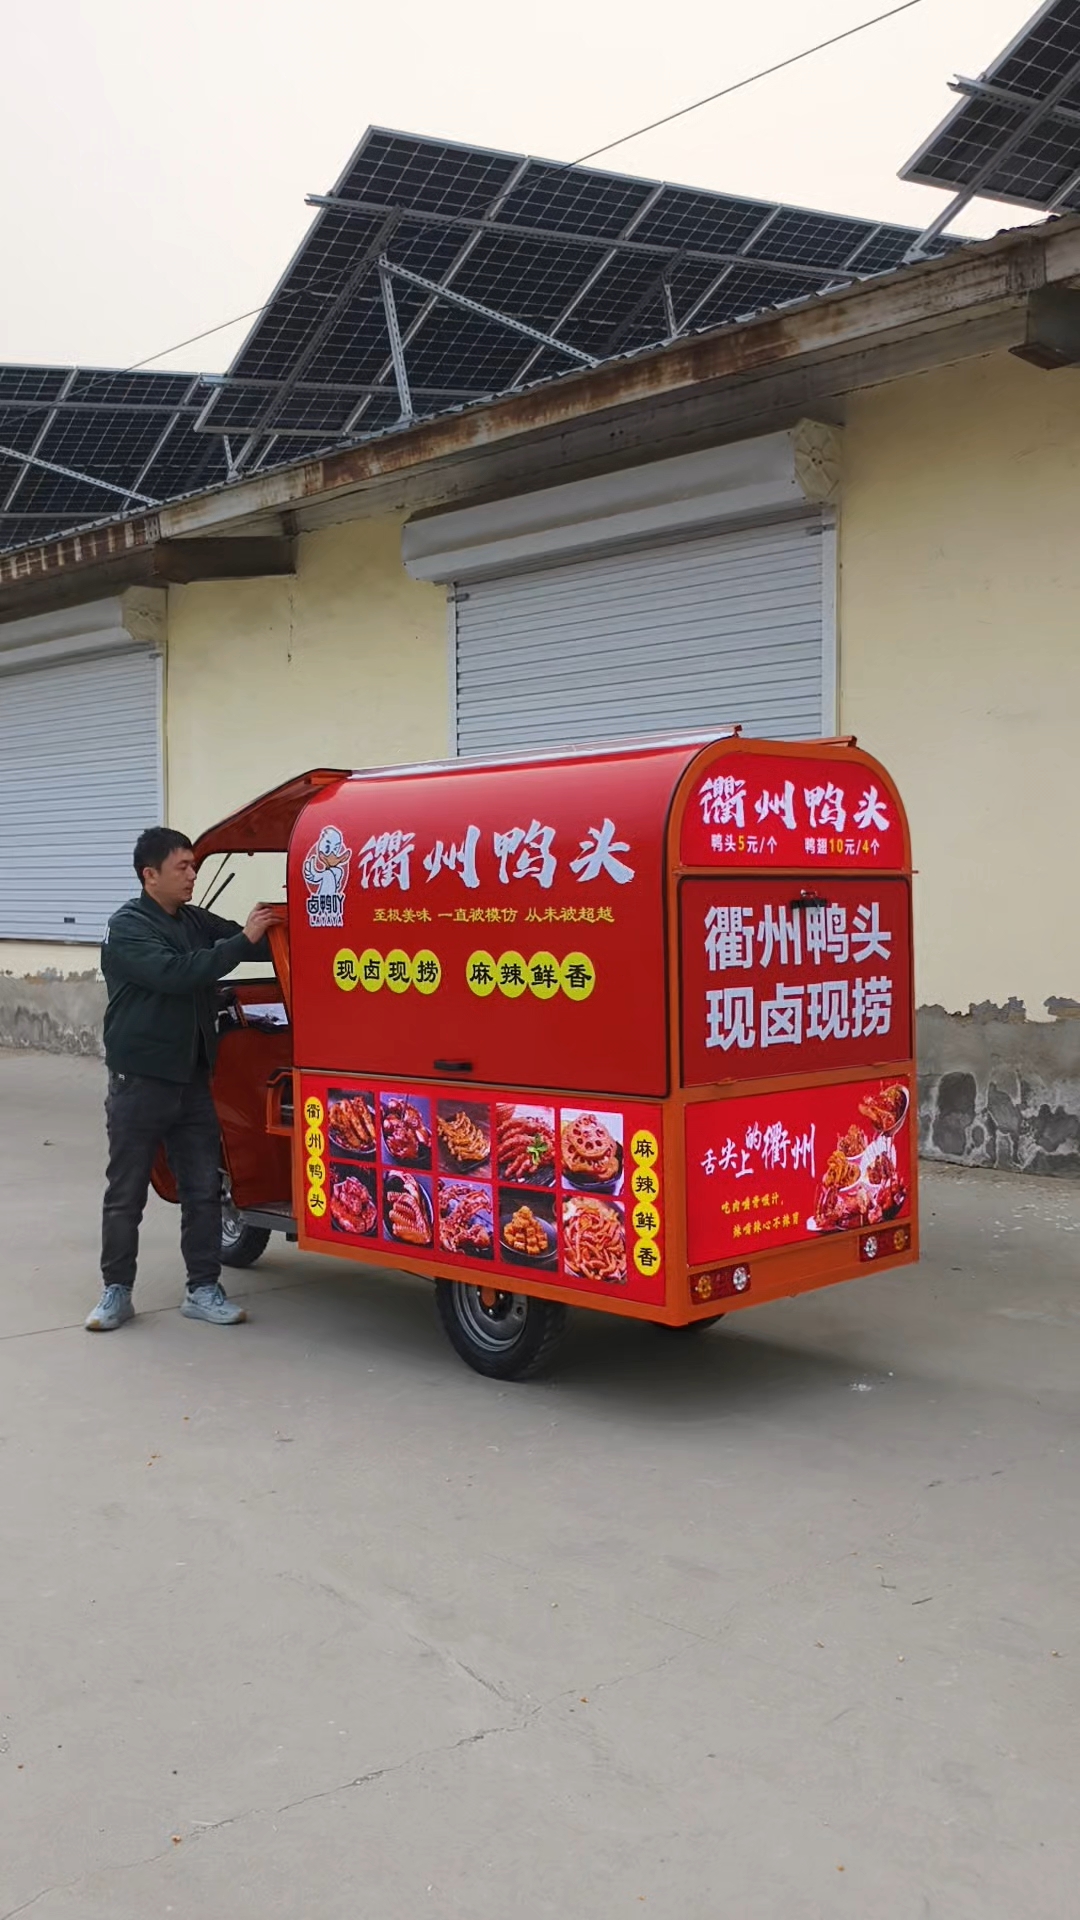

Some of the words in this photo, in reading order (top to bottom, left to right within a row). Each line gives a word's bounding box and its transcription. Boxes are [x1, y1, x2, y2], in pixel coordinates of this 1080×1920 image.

[700, 776, 890, 833] 衢州鸭头
[358, 818, 635, 890] 衢州鸭头
[711, 834, 778, 854] 鸭头5元/个
[373, 908, 432, 923] 至极美味
[438, 907, 518, 923] 一直被模仿
[525, 906, 615, 924] 从未被超越
[704, 902, 891, 971] 衢州鸭头
[337, 959, 439, 984] 现卤现捞
[469, 961, 592, 988] 麻辣鲜香
[705, 976, 892, 1051] 现卤现捞
[307, 1104, 325, 1208] 衢州鸭头
[701, 1121, 816, 1178] 舌尖上的衢州
[634, 1139, 657, 1266] 麻辣鲜香
